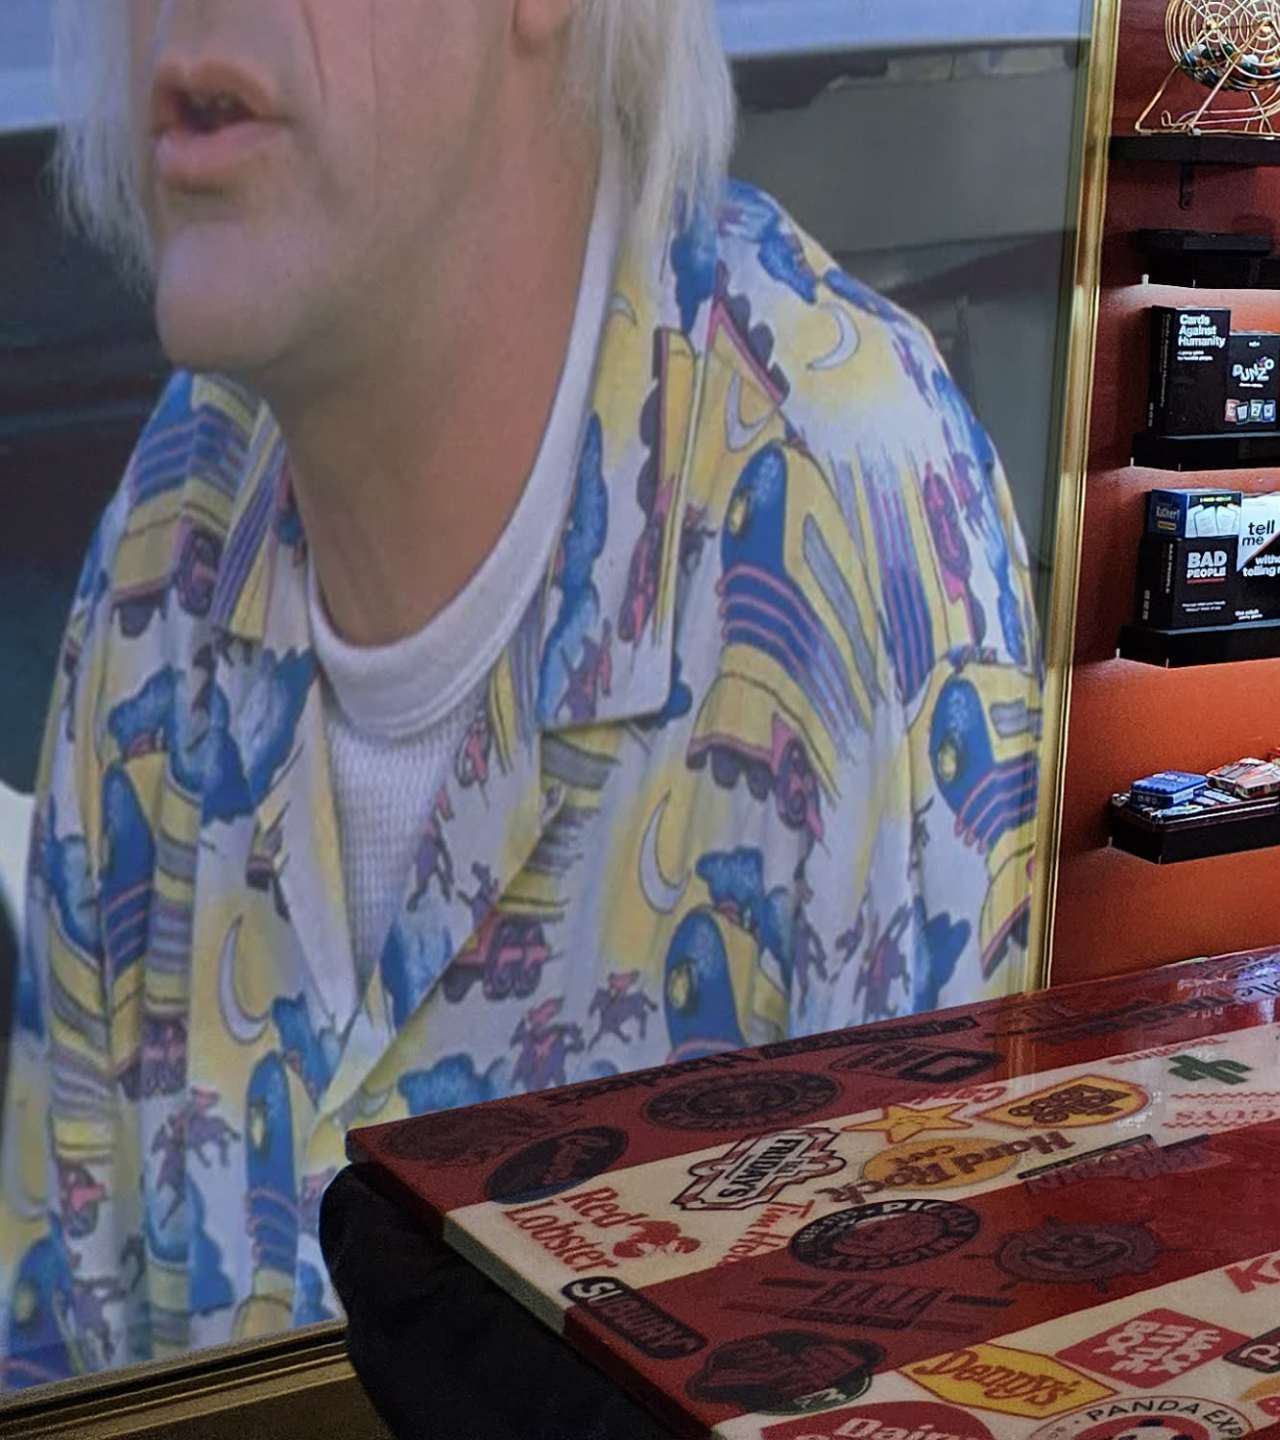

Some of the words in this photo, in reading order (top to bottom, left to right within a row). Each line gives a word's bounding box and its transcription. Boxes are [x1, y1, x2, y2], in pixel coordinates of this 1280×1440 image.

[1179, 314, 1211, 326] Cards
[1178, 325, 1218, 337] Against
[1177, 336, 1227, 348] Humanity
[1248, 520, 1276, 536] tell
[1242, 535, 1264, 546] me
[1187, 550, 1228, 568] BAD
[1186, 566, 1227, 579] PEOPLE
[1243, 565, 1276, 578] telling
[953, 1131, 1077, 1176] Hard
[719, 1137, 802, 1200] FRIDAY'S
[814, 1160, 954, 1206] Rock
[559, 1186, 650, 1229] Red
[502, 1200, 620, 1272] Lobster
[571, 1280, 698, 1357] SUBWAY
[911, 1351, 1082, 1408] Denny's
[1086, 1398, 1202, 1422] PANDA
